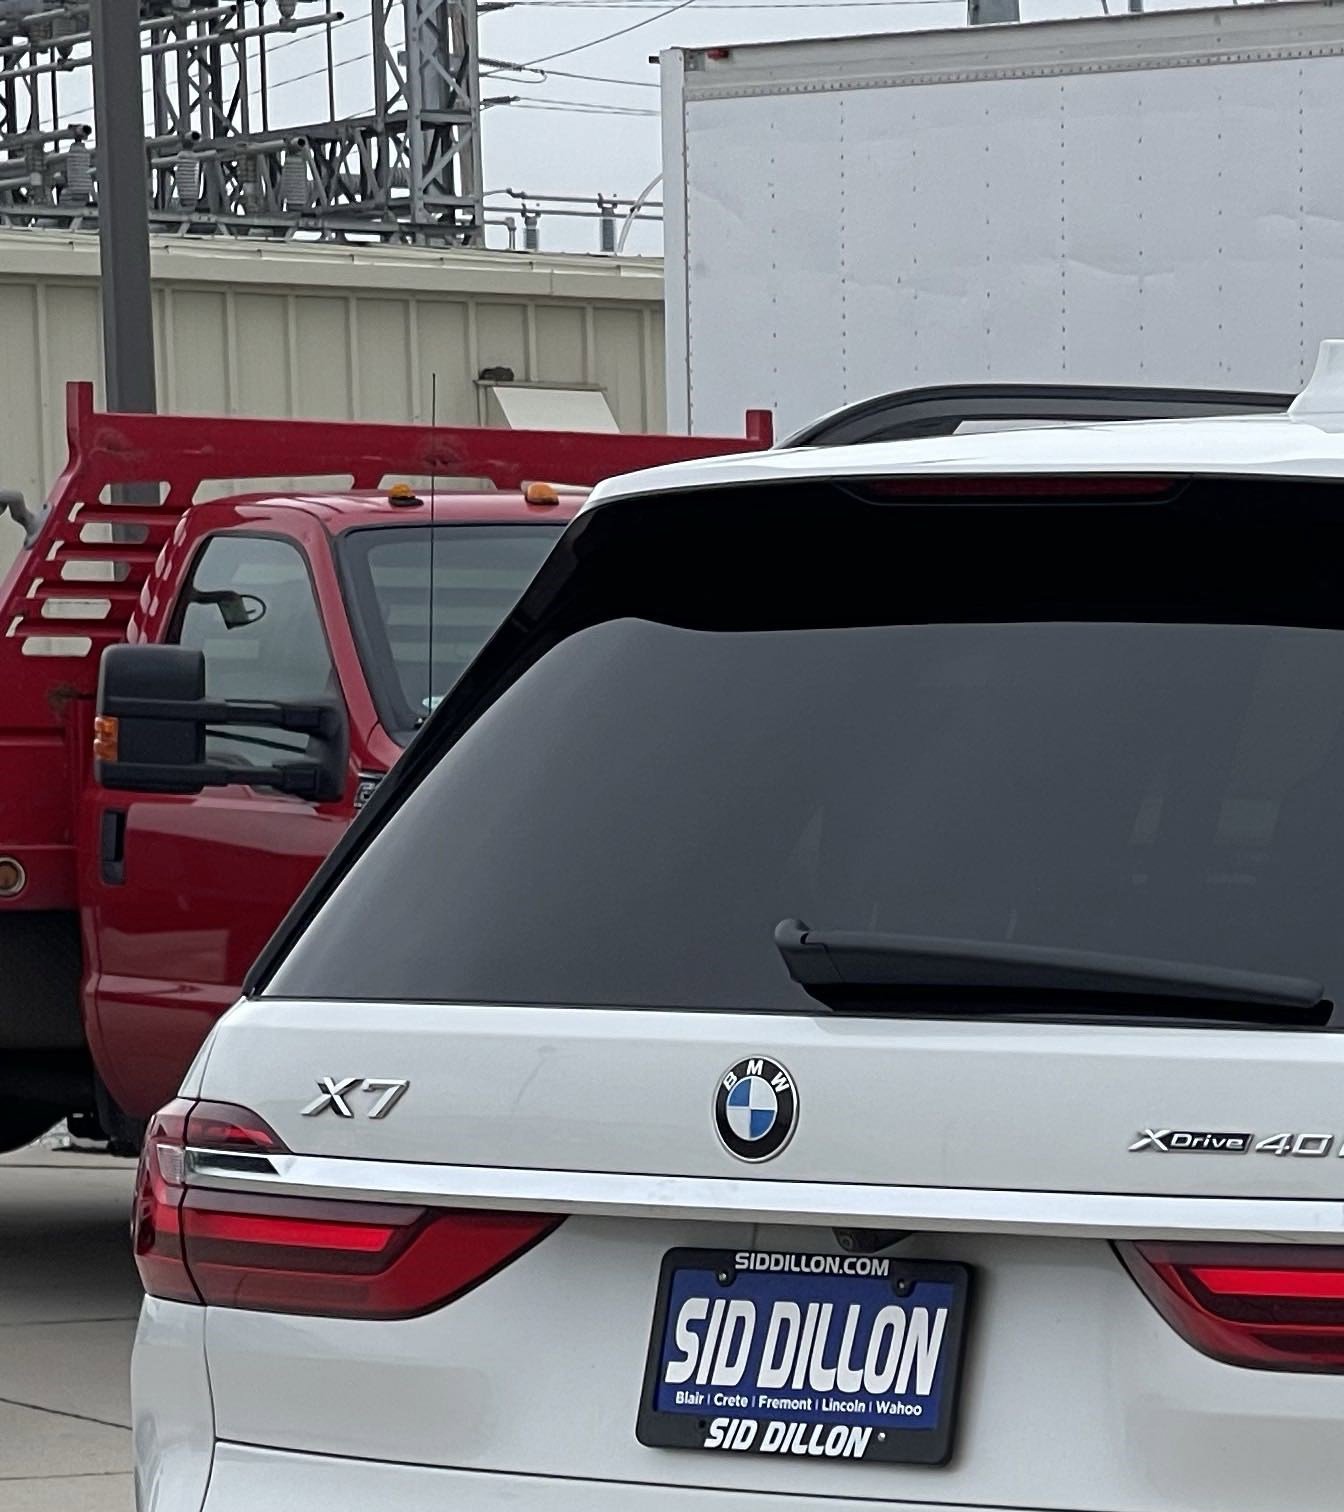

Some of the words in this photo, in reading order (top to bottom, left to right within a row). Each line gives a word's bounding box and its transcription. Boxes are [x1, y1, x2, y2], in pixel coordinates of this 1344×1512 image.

[723, 1059, 790, 1092] BMW
[300, 1076, 410, 1119] X7
[735, 1252, 889, 1277] SIDDILLON.COM
[664, 1297, 756, 1387] SID
[756, 1300, 948, 1396] DILLON
[676, 1391, 704, 1406] Blair
[713, 1393, 748, 1408] Crete
[758, 1395, 813, 1411] Fremont
[822, 1398, 866, 1413] Lincoln
[876, 1400, 922, 1416] Wahoo
[704, 1417, 757, 1450] SID
[760, 1421, 872, 1458] DILLON
